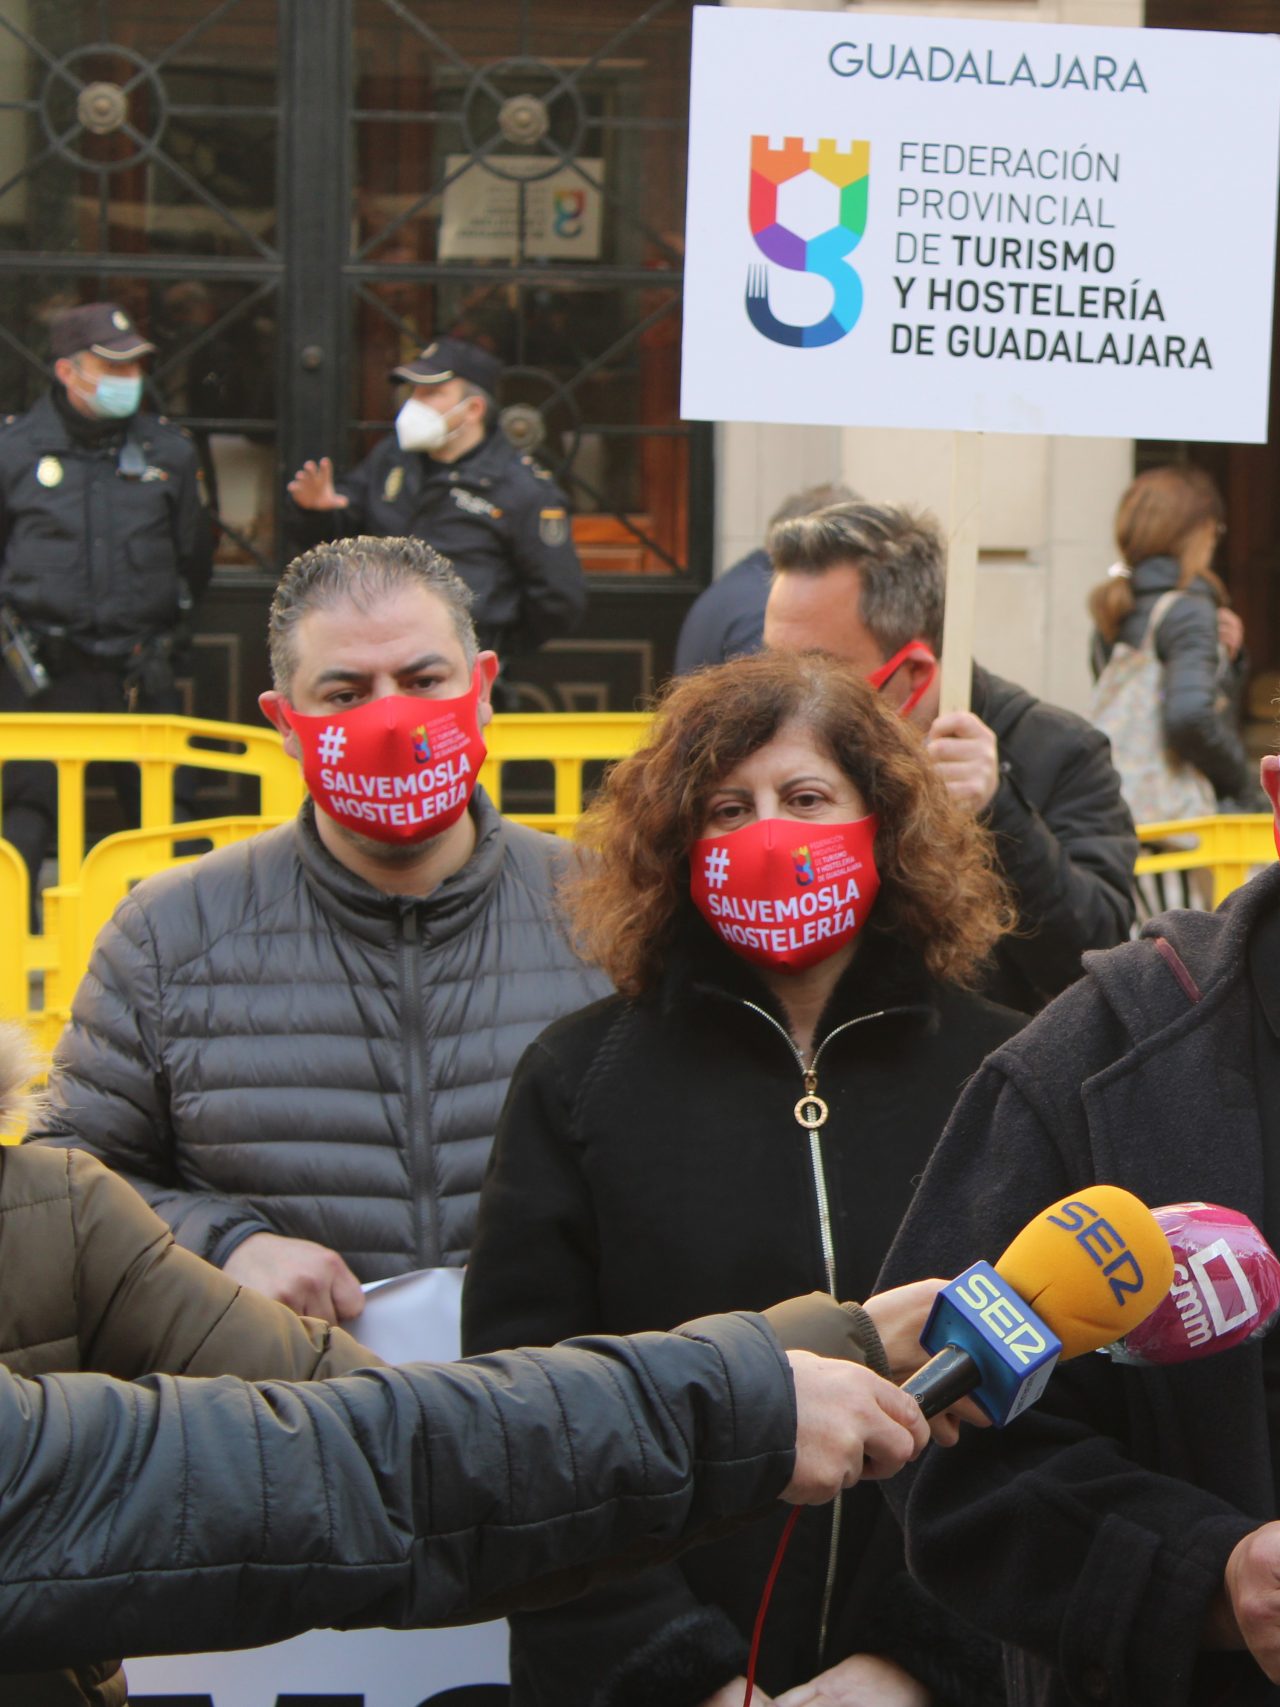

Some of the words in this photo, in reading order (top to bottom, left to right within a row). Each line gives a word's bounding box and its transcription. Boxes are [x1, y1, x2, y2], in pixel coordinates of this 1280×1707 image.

[828, 41, 1149, 94] GUADALAJARA
[898, 141, 1120, 184] FEDERACIÓN
[896, 187, 1117, 229] PROVINCIAL
[895, 232, 942, 266] DE
[952, 235, 1116, 275] TURISMO
[893, 276, 917, 310] Y
[928, 278, 1166, 322] HOSTELERÍA
[890, 324, 935, 357] DE
[946, 325, 1214, 371] GUADALAJARA
[319, 752, 472, 799] SALVEMOSLA
[328, 780, 468, 826] HOSTELERÍA
[708, 878, 861, 923] SALVEMOSLA
[717, 907, 856, 952] HOSTELERÍA
[1046, 1200, 1145, 1307] SER
[954, 1272, 1047, 1365] SER
